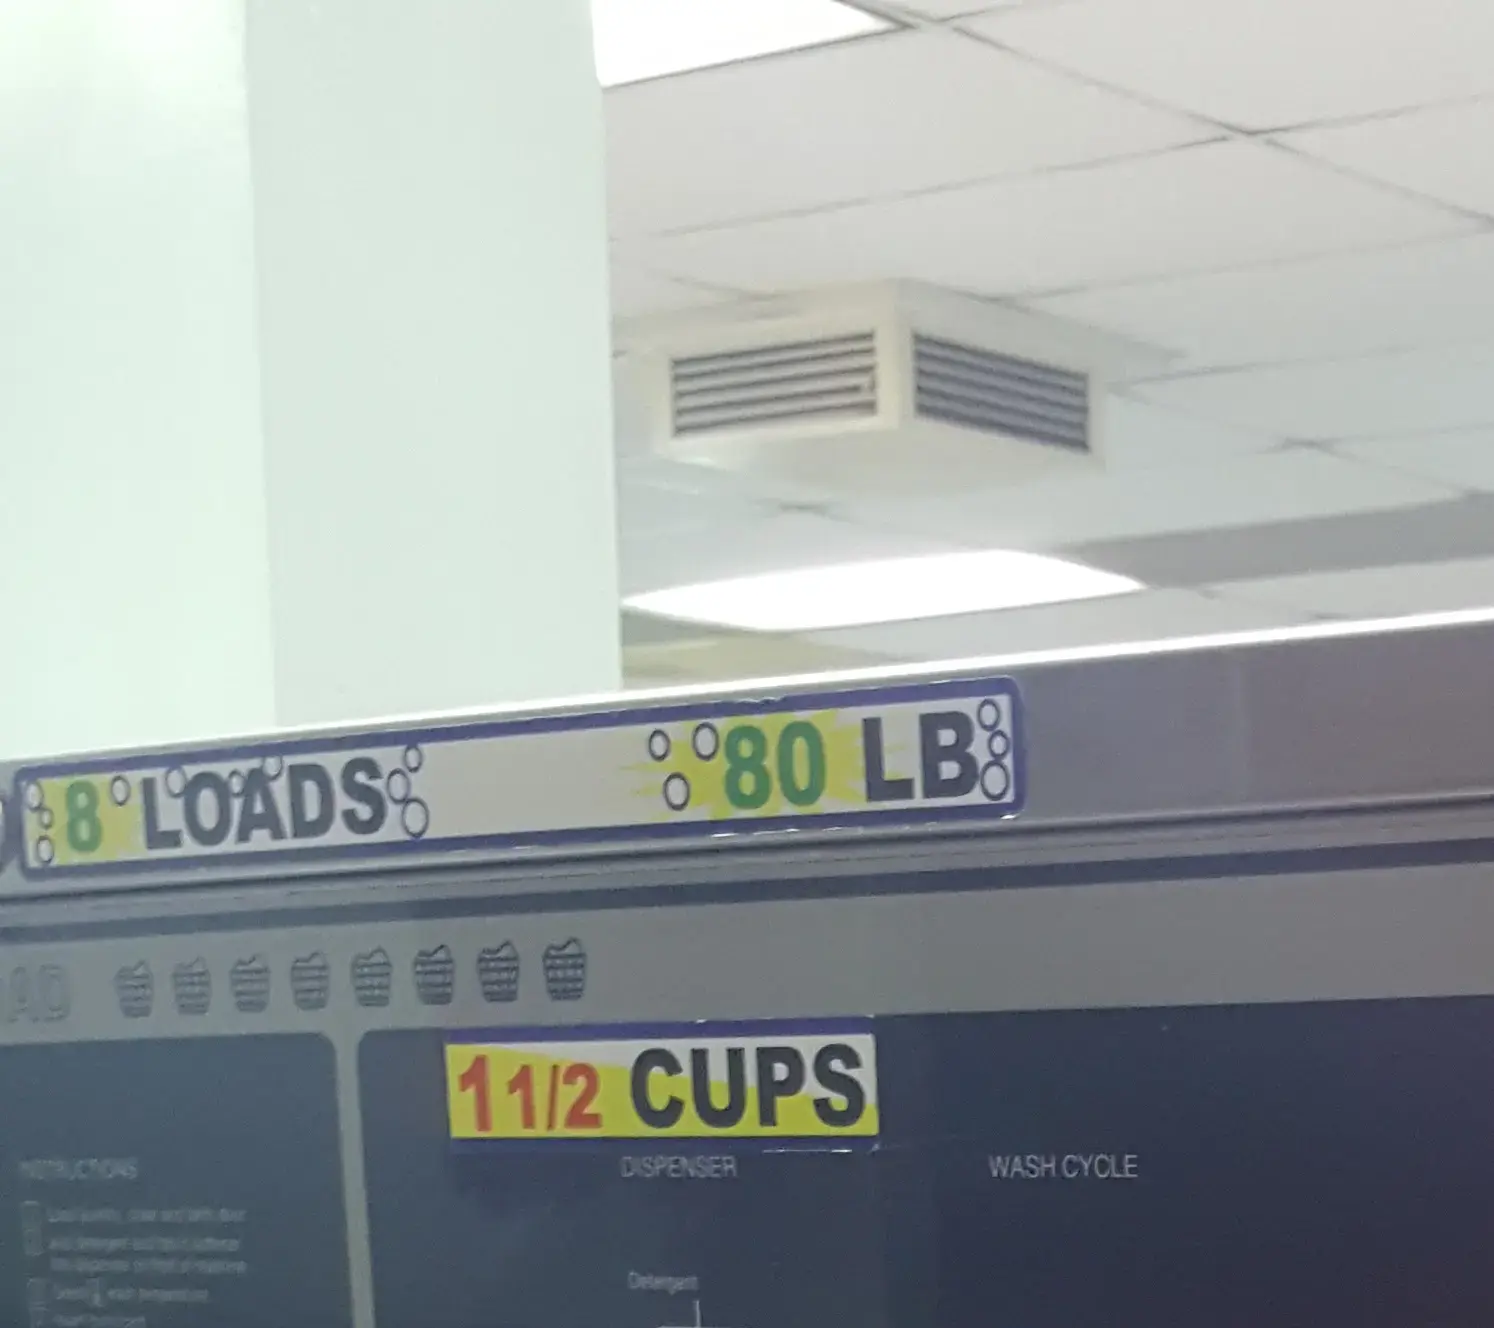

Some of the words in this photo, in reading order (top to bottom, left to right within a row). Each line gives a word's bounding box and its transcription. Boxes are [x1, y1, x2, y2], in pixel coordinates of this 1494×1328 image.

[724, 720, 826, 810] 80
[862, 710, 979, 802] LB
[66, 780, 102, 853] 8
[139, 757, 388, 850] LOADS
[631, 1043, 865, 1129] CUPS
[620, 1155, 738, 1178] DISPENSER
[988, 1154, 1056, 1178] WASH
[1061, 1154, 1138, 1178] CYCLE
